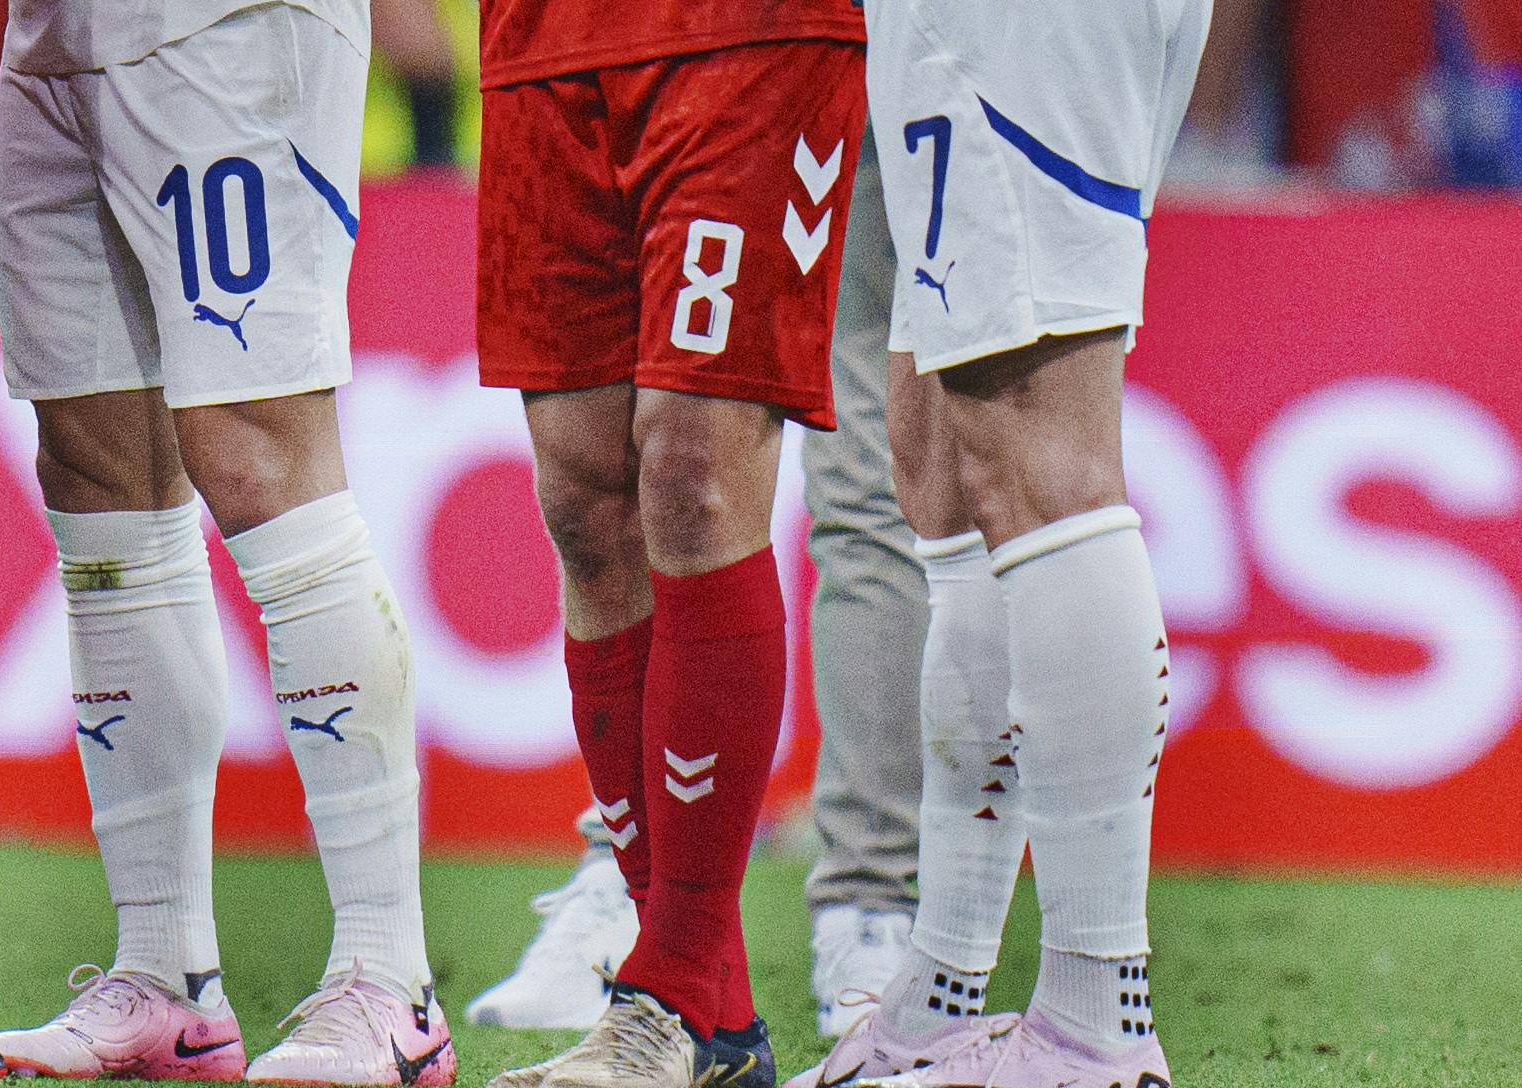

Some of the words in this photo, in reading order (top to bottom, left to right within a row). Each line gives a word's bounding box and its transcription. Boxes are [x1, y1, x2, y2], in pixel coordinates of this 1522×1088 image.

[157, 156, 271, 302] 10
[905, 115, 951, 260] 7
[670, 219, 744, 353] 8
